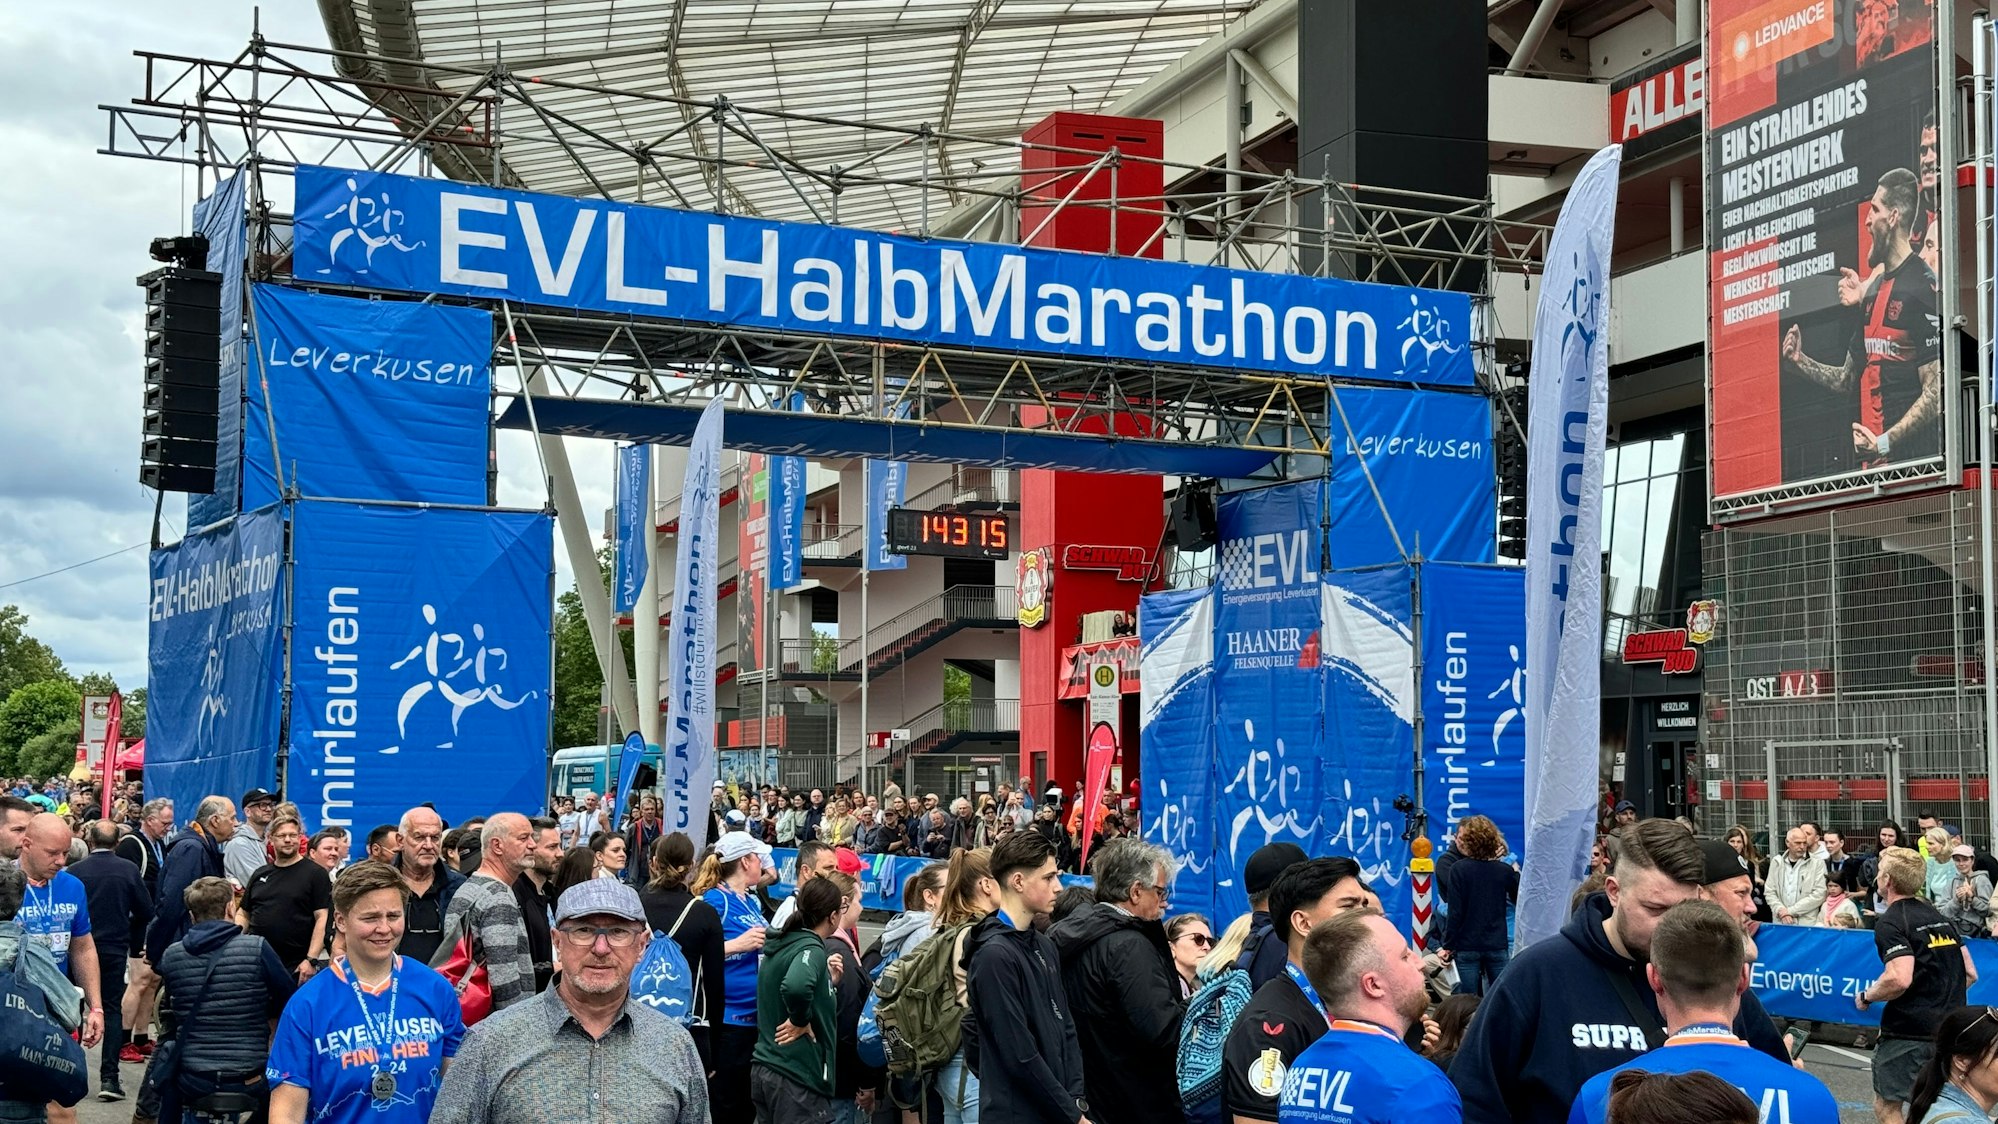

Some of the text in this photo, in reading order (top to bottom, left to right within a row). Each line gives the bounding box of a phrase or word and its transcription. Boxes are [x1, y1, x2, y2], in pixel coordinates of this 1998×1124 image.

[1755, 1, 1825, 48] LEDVANCE
[1722, 78, 1868, 167] EIN STRAHLENDES
[1722, 129, 1844, 206] MEISTERWERK
[1722, 166, 1859, 229] EUER NACHHALTIGKEITSPARTNER
[1723, 207, 1815, 254] LICHT & BELEUCHTUNG
[1723, 231, 1817, 278] BEGLÜCKWÜNSCHT DIE
[439, 191, 1377, 370] EVL-HalbMarathon
[1724, 251, 1835, 302] WERKSELF ZUR DEUTSCHEN
[1724, 289, 1791, 327] MEISTERSCHAFT
[269, 337, 473, 386] Leverkusen
[1346, 432, 1481, 460] Leverkusen
[1067, 546, 1142, 563] SCHWAD
[1254, 529, 1318, 589] EVL
[1223, 590, 1283, 607] Energieversorgung
[1227, 627, 1302, 656] HAANER
[1625, 630, 1686, 653] SCHWAD
[1234, 655, 1295, 670] FELSENQUELLE
[1663, 650, 1696, 672] BUD
[1747, 677, 1776, 700] OST
[1661, 702, 1689, 712] HERZLICH
[1657, 717, 1696, 728] WILLKOMMEN
[1750, 962, 1833, 999] Energie
[6, 993, 26, 1011] LTB
[44, 1032, 62, 1052] 7th
[341, 1041, 430, 1070] FINIHER
[19, 1045, 77, 1076] MAIN-STREET
[370, 1060, 407, 1079] 224
[1297, 1067, 1355, 1115] EVL
